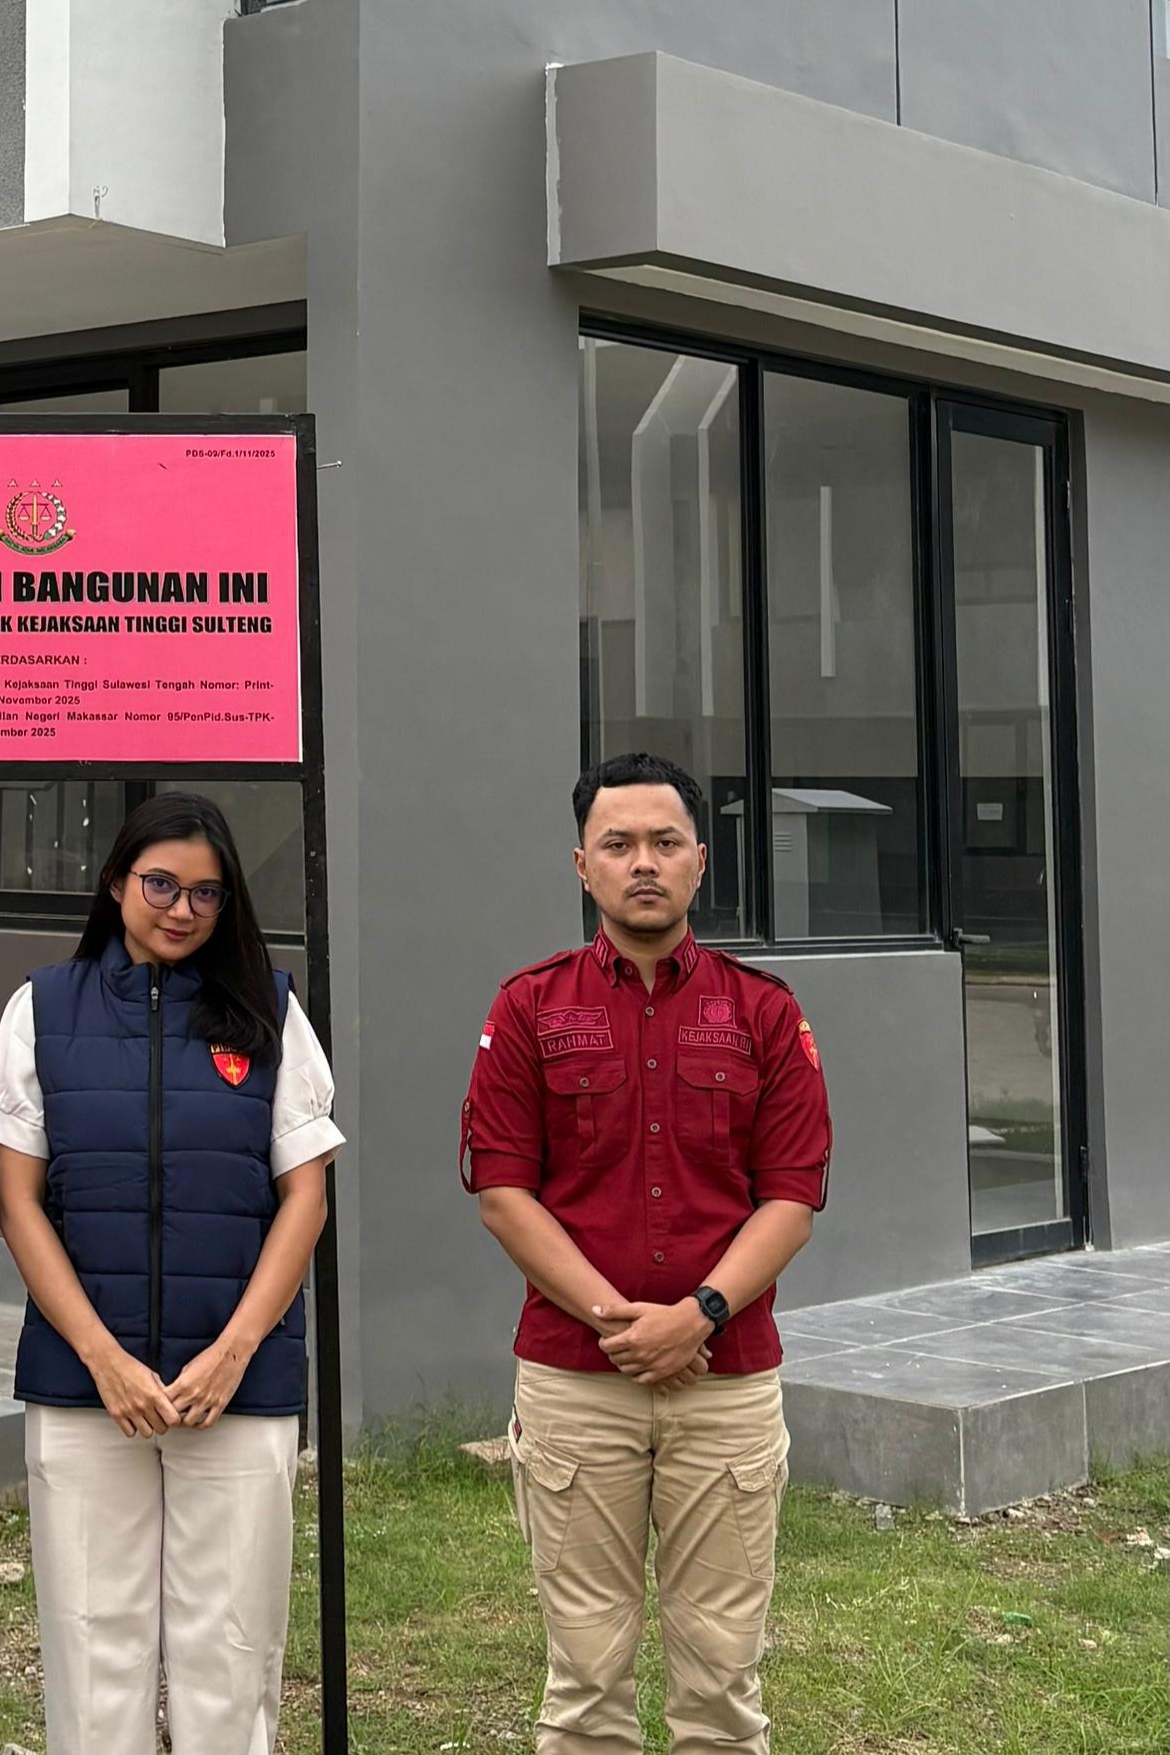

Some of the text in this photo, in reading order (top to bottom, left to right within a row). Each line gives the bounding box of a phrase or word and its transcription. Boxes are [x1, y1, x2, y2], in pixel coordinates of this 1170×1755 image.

[13, 571, 208, 603] BANGUNAN
[218, 572, 269, 603] INI
[18, 616, 120, 633] KEJAKSAAN
[124, 616, 187, 633] TINGGI
[192, 616, 272, 633] SULTENG
[4, 679, 60, 692] Kejaksaan
[64, 679, 98, 692] Tinggi
[102, 679, 151, 690] Sulawesi
[155, 679, 195, 692] Tengah
[200, 680, 239, 690] Nomor:
[244, 680, 274, 690] Print-
[55, 695, 81, 705] 2025
[25, 711, 60, 723] Negeri
[66, 711, 118, 721] Makassar
[124, 711, 161, 721] Nomor
[30, 727, 56, 737] 2025
[547, 1034, 605, 1052] RAHMAT
[681, 1029, 750, 1050] KEJAKSAAN RI
